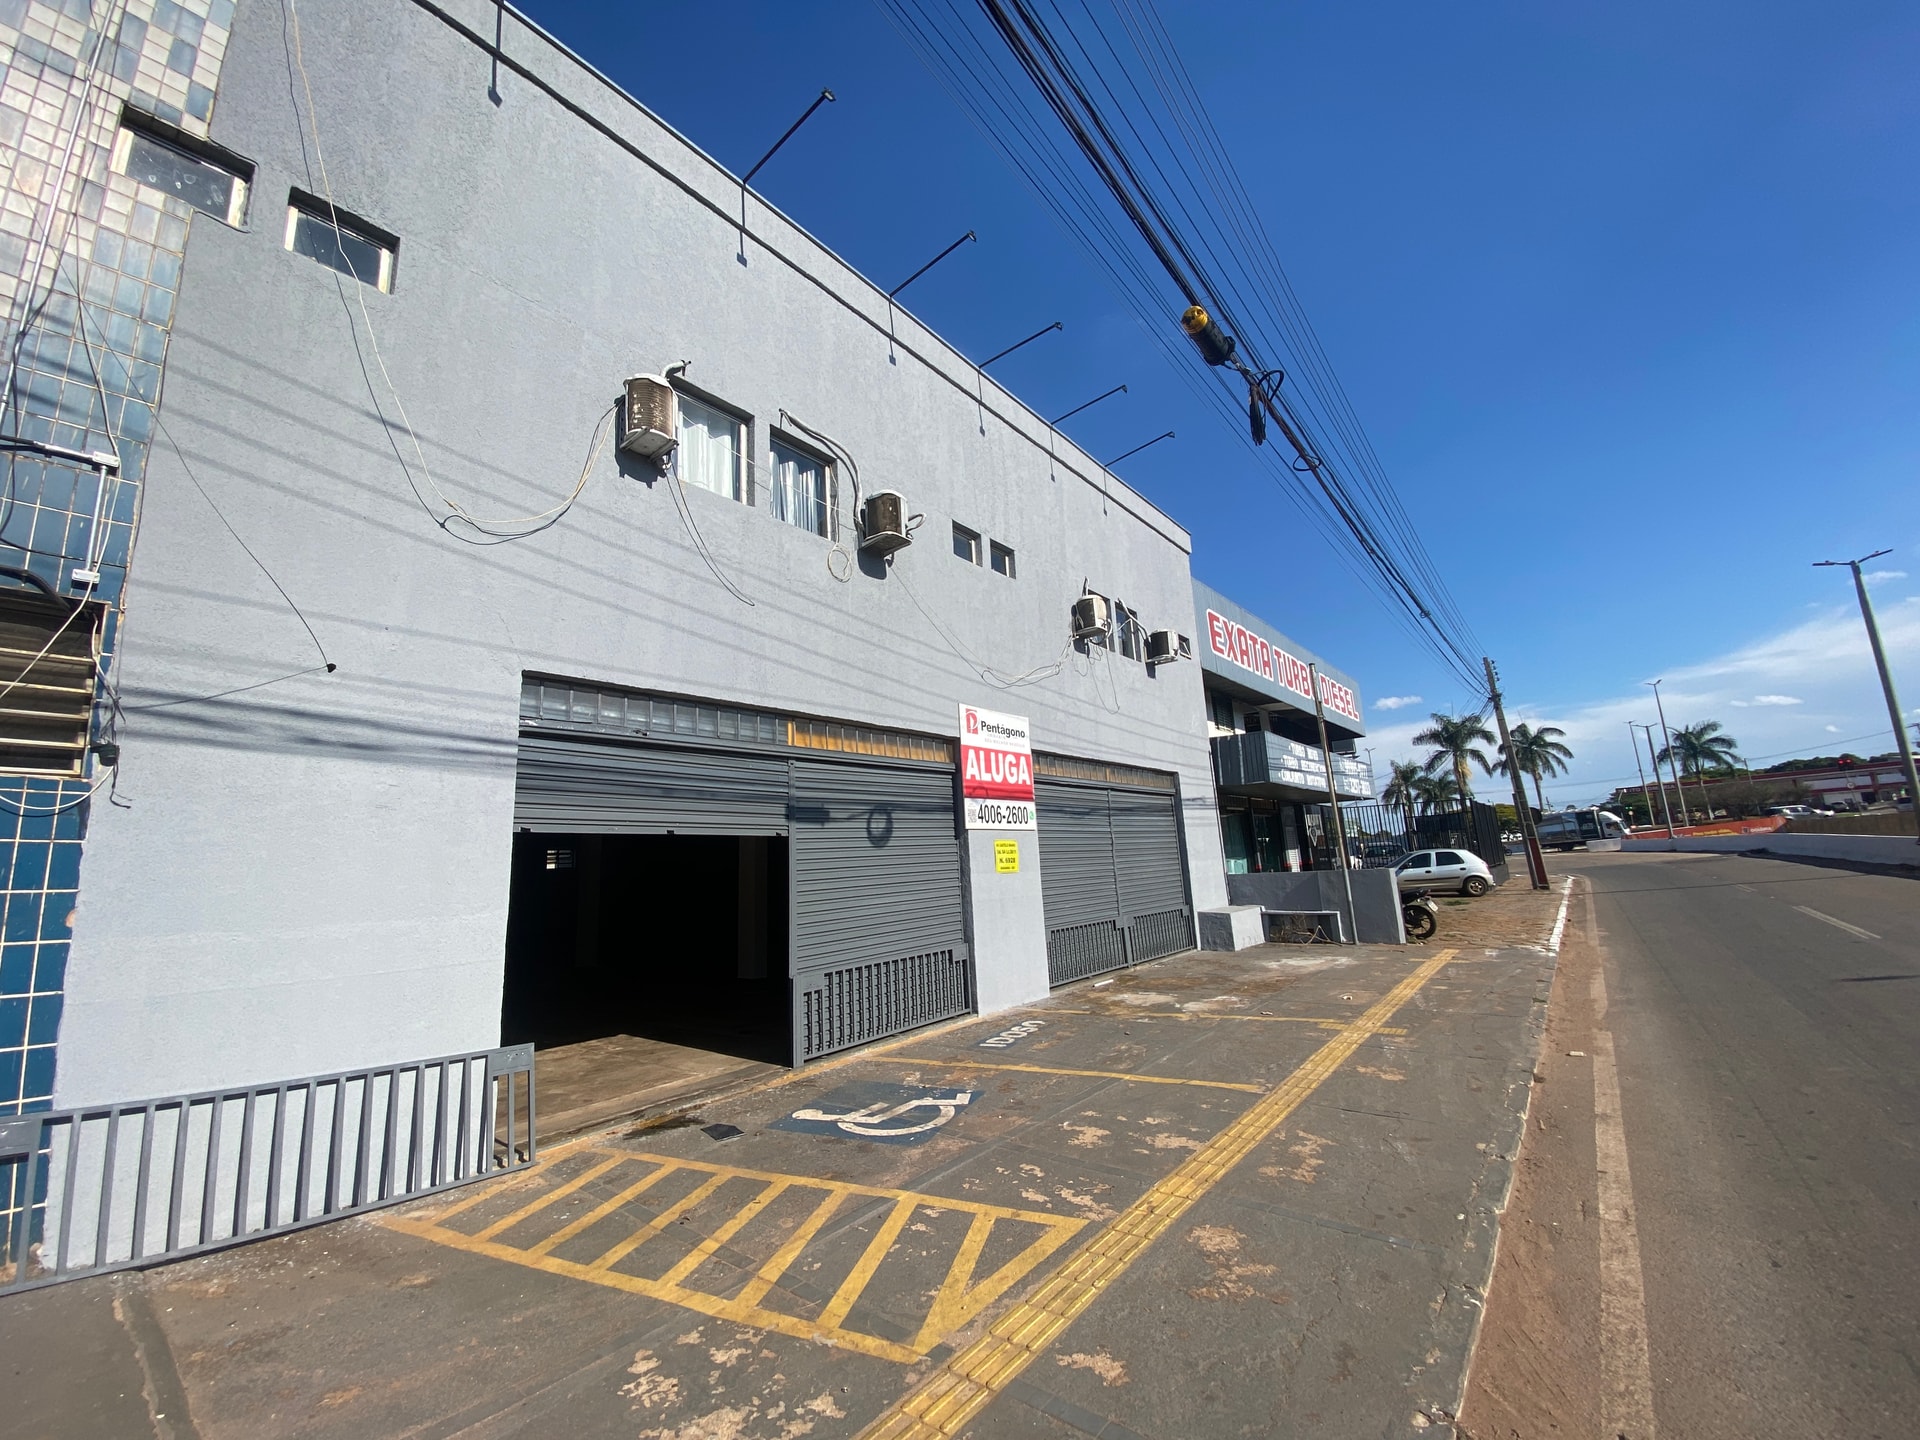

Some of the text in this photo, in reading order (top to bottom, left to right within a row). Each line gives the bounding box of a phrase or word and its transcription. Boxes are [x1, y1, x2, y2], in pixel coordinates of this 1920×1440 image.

[1206, 608, 1274, 682] EXATA
[1319, 672, 1360, 722] DIESEL
[966, 749, 1031, 785] ALUGA
[978, 804, 1028, 824] 4006-2600
